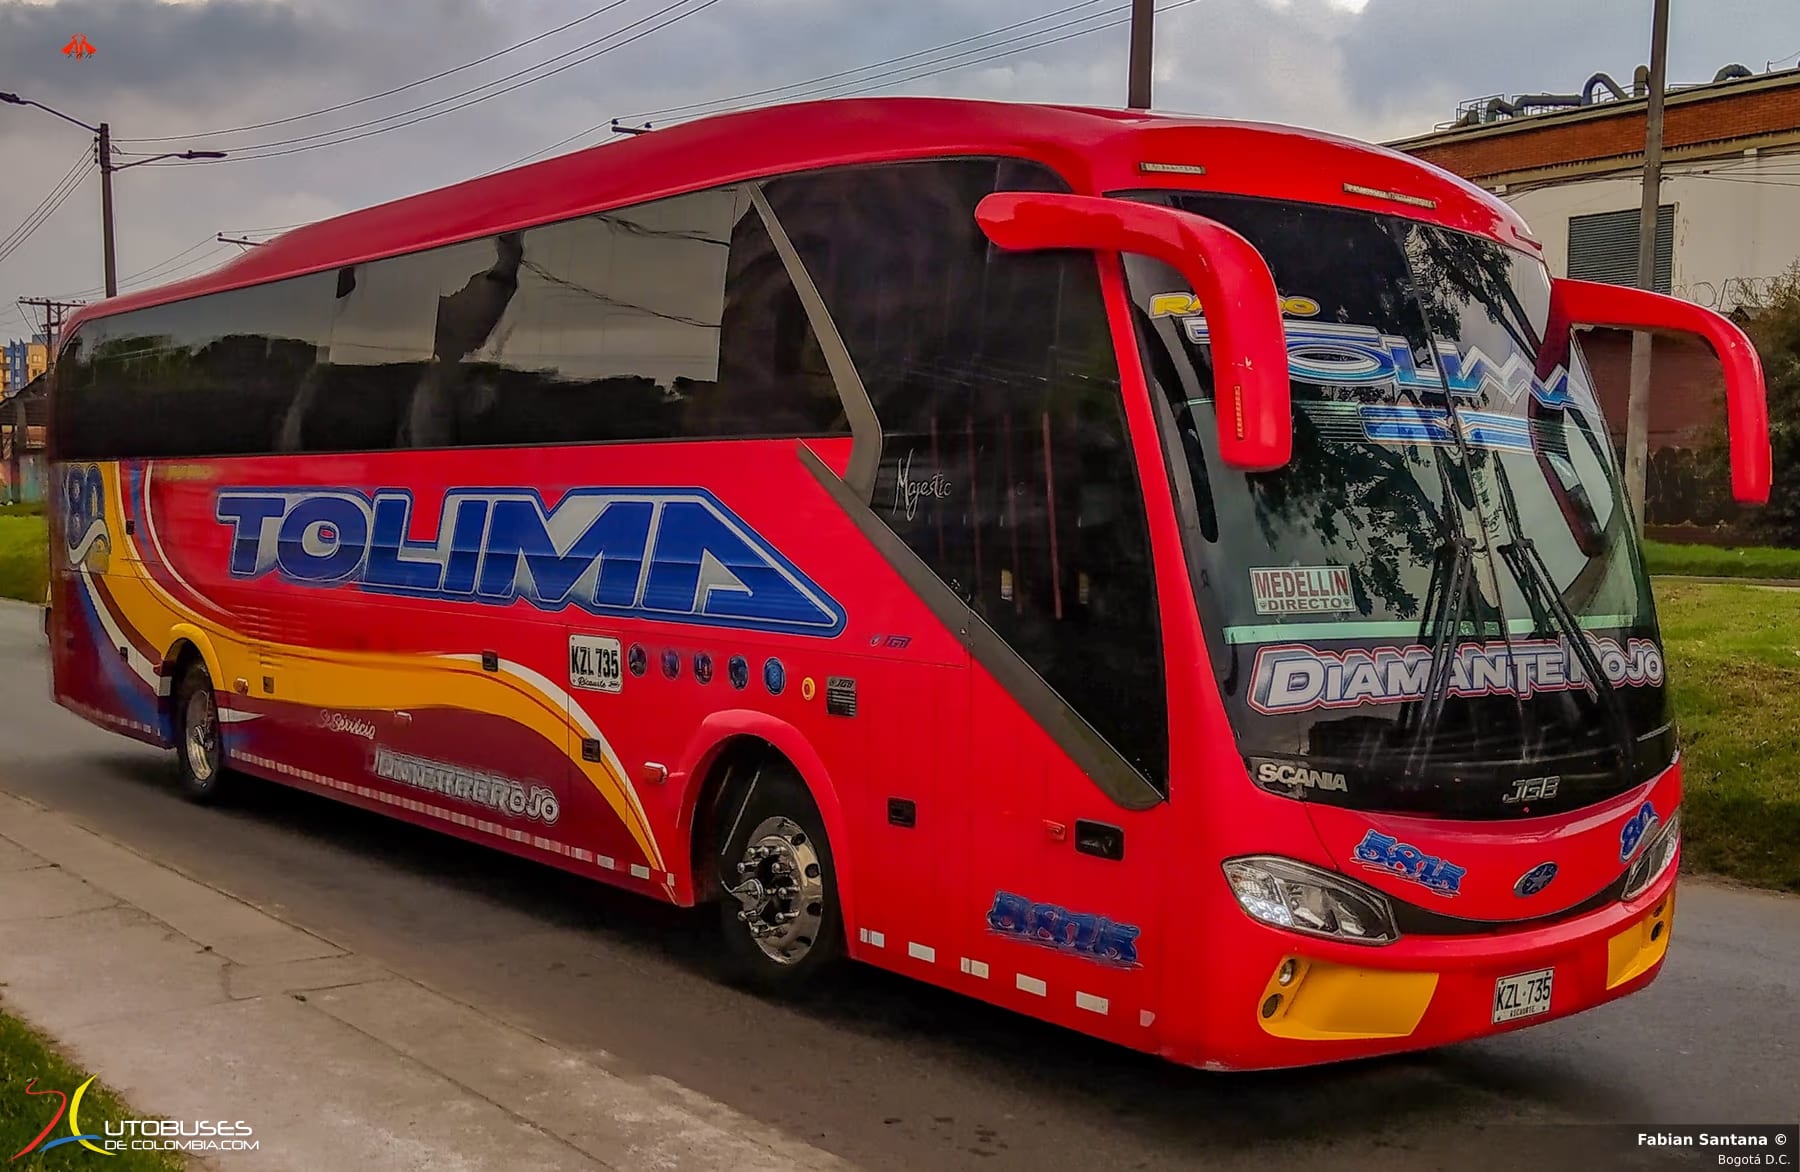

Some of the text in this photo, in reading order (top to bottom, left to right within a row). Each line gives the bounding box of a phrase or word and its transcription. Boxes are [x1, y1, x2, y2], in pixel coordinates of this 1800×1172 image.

[893, 448, 952, 521] Majestic
[214, 486, 848, 638] TOLIMA
[1253, 570, 1349, 599] MEDELLIN
[1268, 598, 1342, 611] DIRECTO
[1258, 762, 1348, 793] SCANIA
[1502, 775, 1560, 804] JGB
